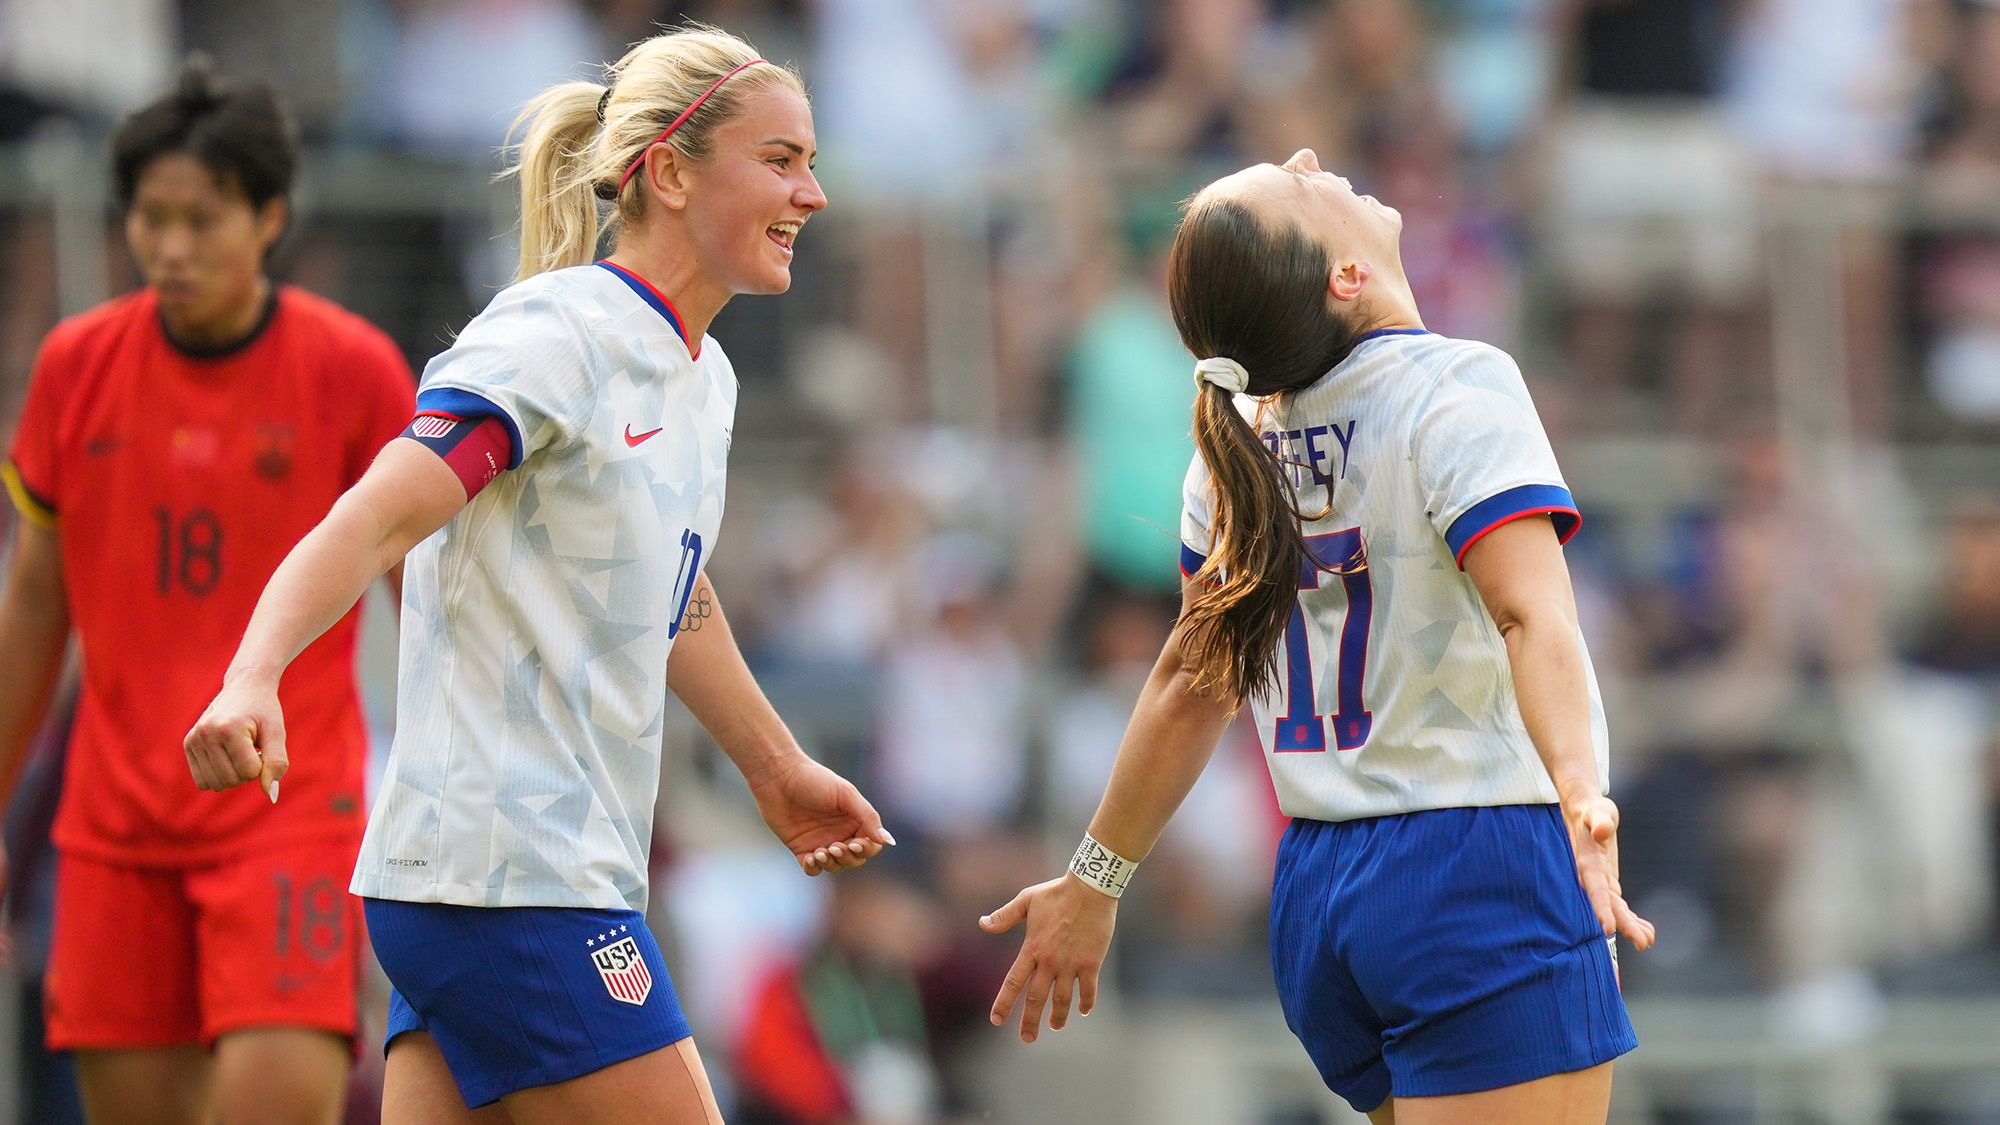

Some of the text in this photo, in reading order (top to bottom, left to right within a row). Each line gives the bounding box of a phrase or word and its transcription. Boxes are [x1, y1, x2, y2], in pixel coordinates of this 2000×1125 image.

[154, 507, 224, 597] 18
[668, 528, 702, 640] 0
[1273, 526, 1373, 753] 17
[1082, 846, 1108, 880] A01
[275, 873, 345, 964] 18
[595, 940, 638, 970] USA
